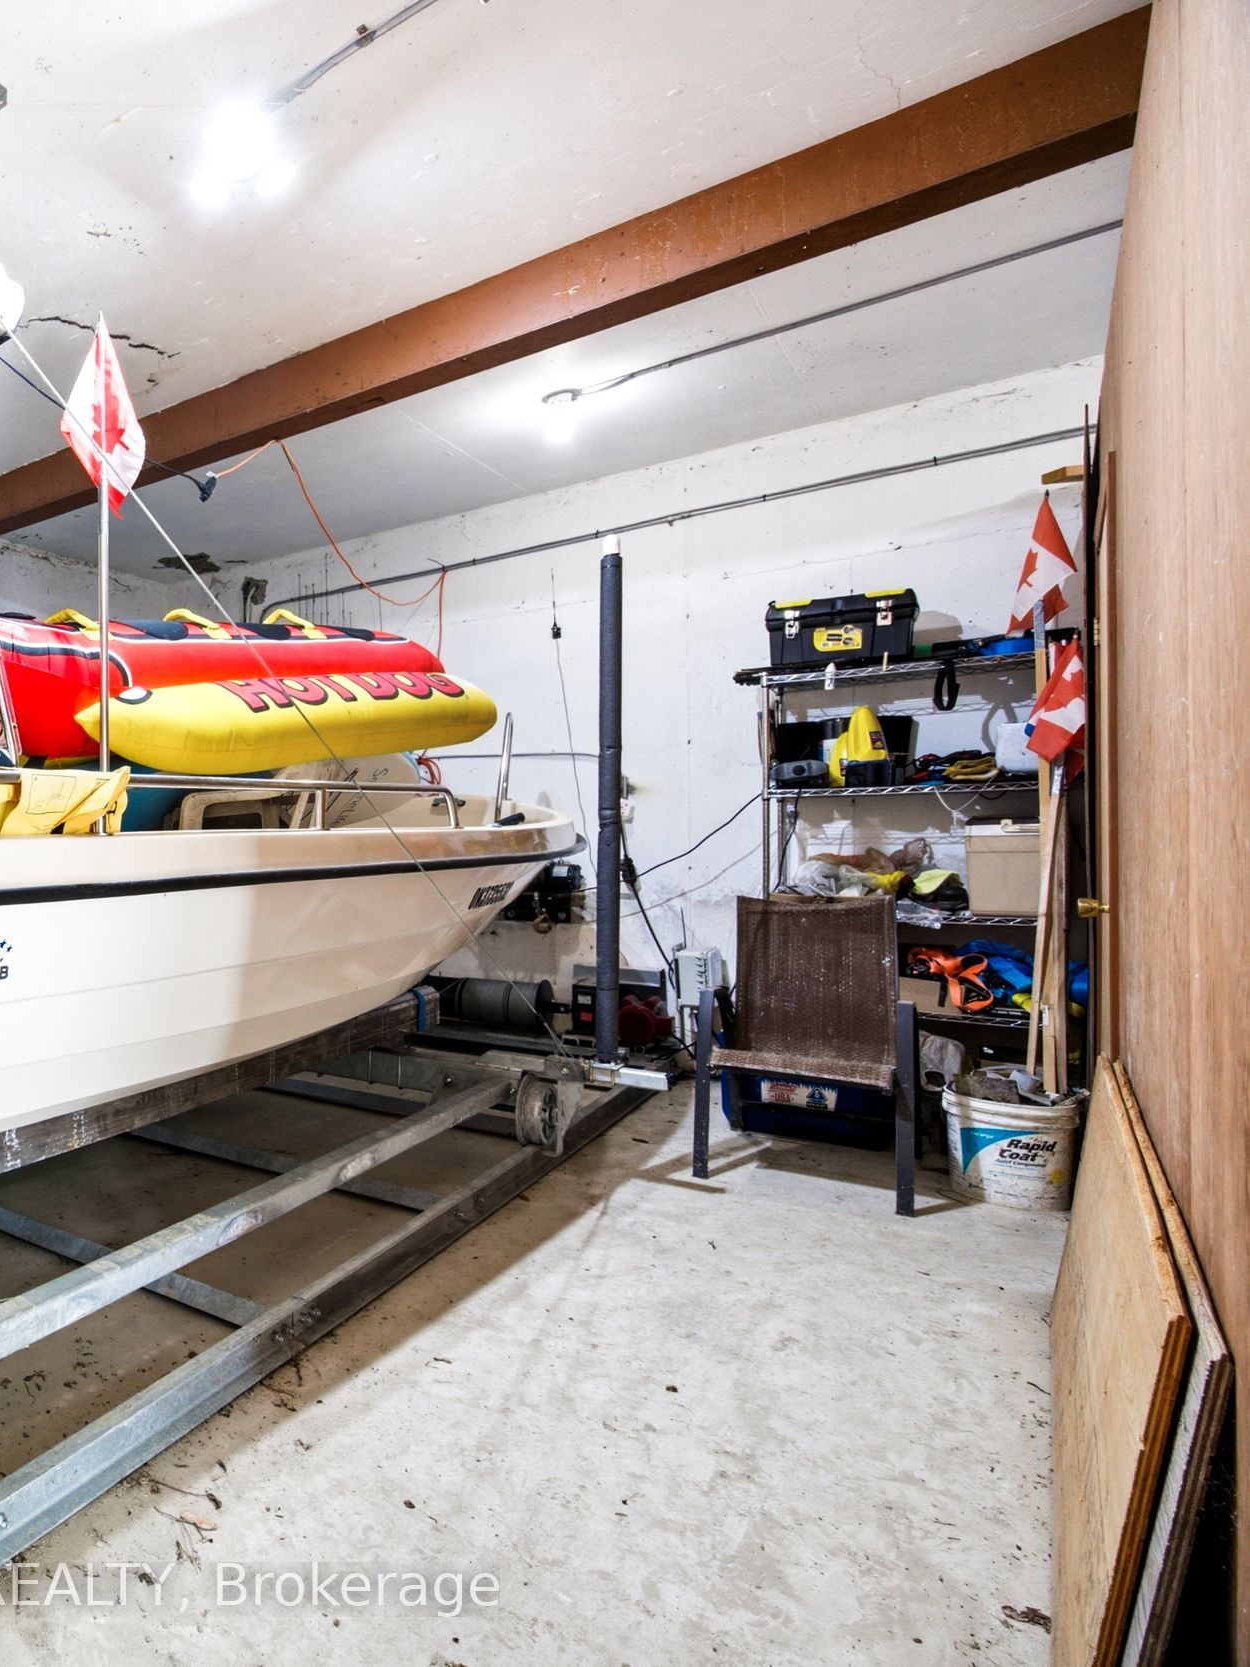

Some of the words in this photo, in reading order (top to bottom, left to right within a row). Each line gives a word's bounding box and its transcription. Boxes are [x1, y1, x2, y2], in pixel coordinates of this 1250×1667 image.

[213, 674, 358, 713] HOT
[348, 672, 465, 701] DOG
[1007, 1138, 1058, 1154] Rapid
[998, 1149, 1040, 1162] Coat
